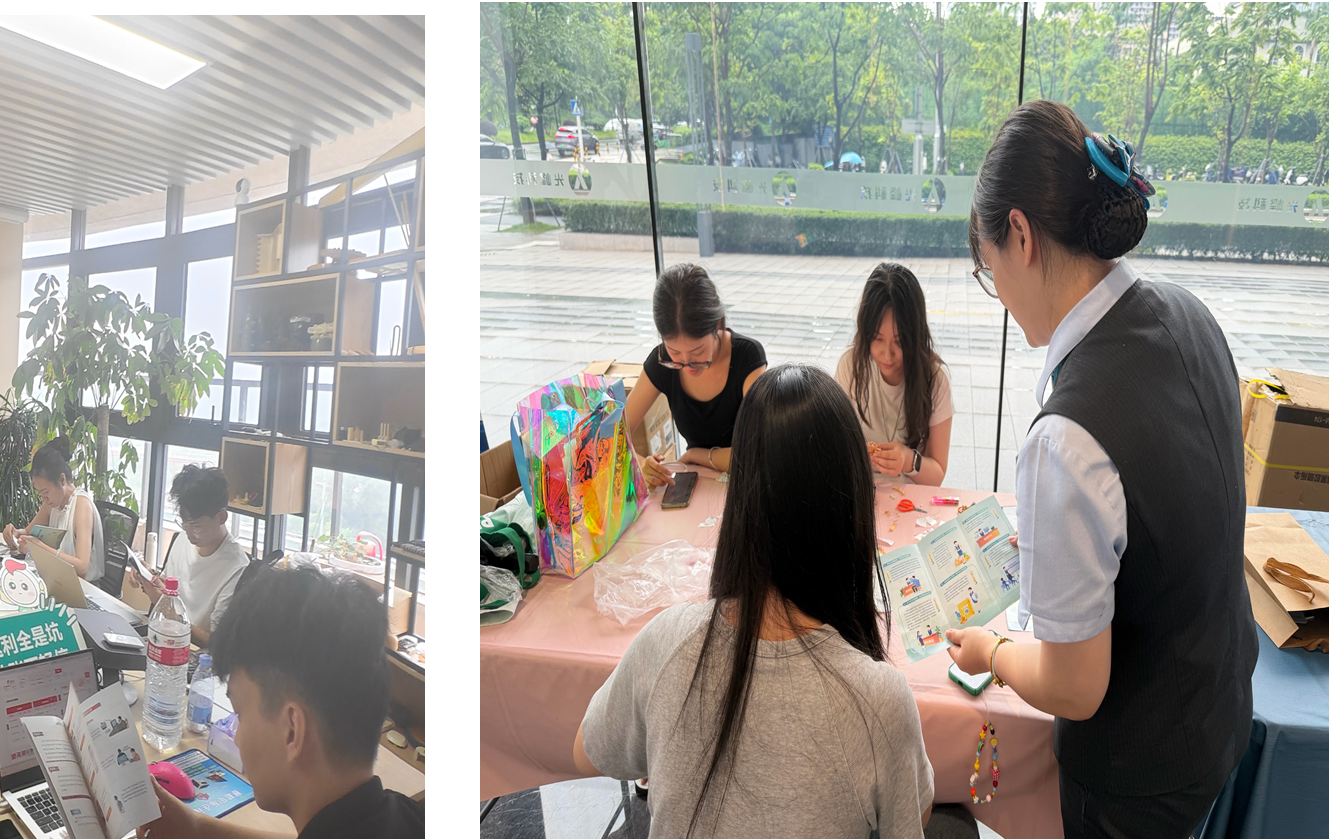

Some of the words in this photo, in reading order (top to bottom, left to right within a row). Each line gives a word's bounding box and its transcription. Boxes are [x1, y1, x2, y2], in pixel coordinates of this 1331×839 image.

[1293, 471, 1329, 484] 黑胶晴雨伞
